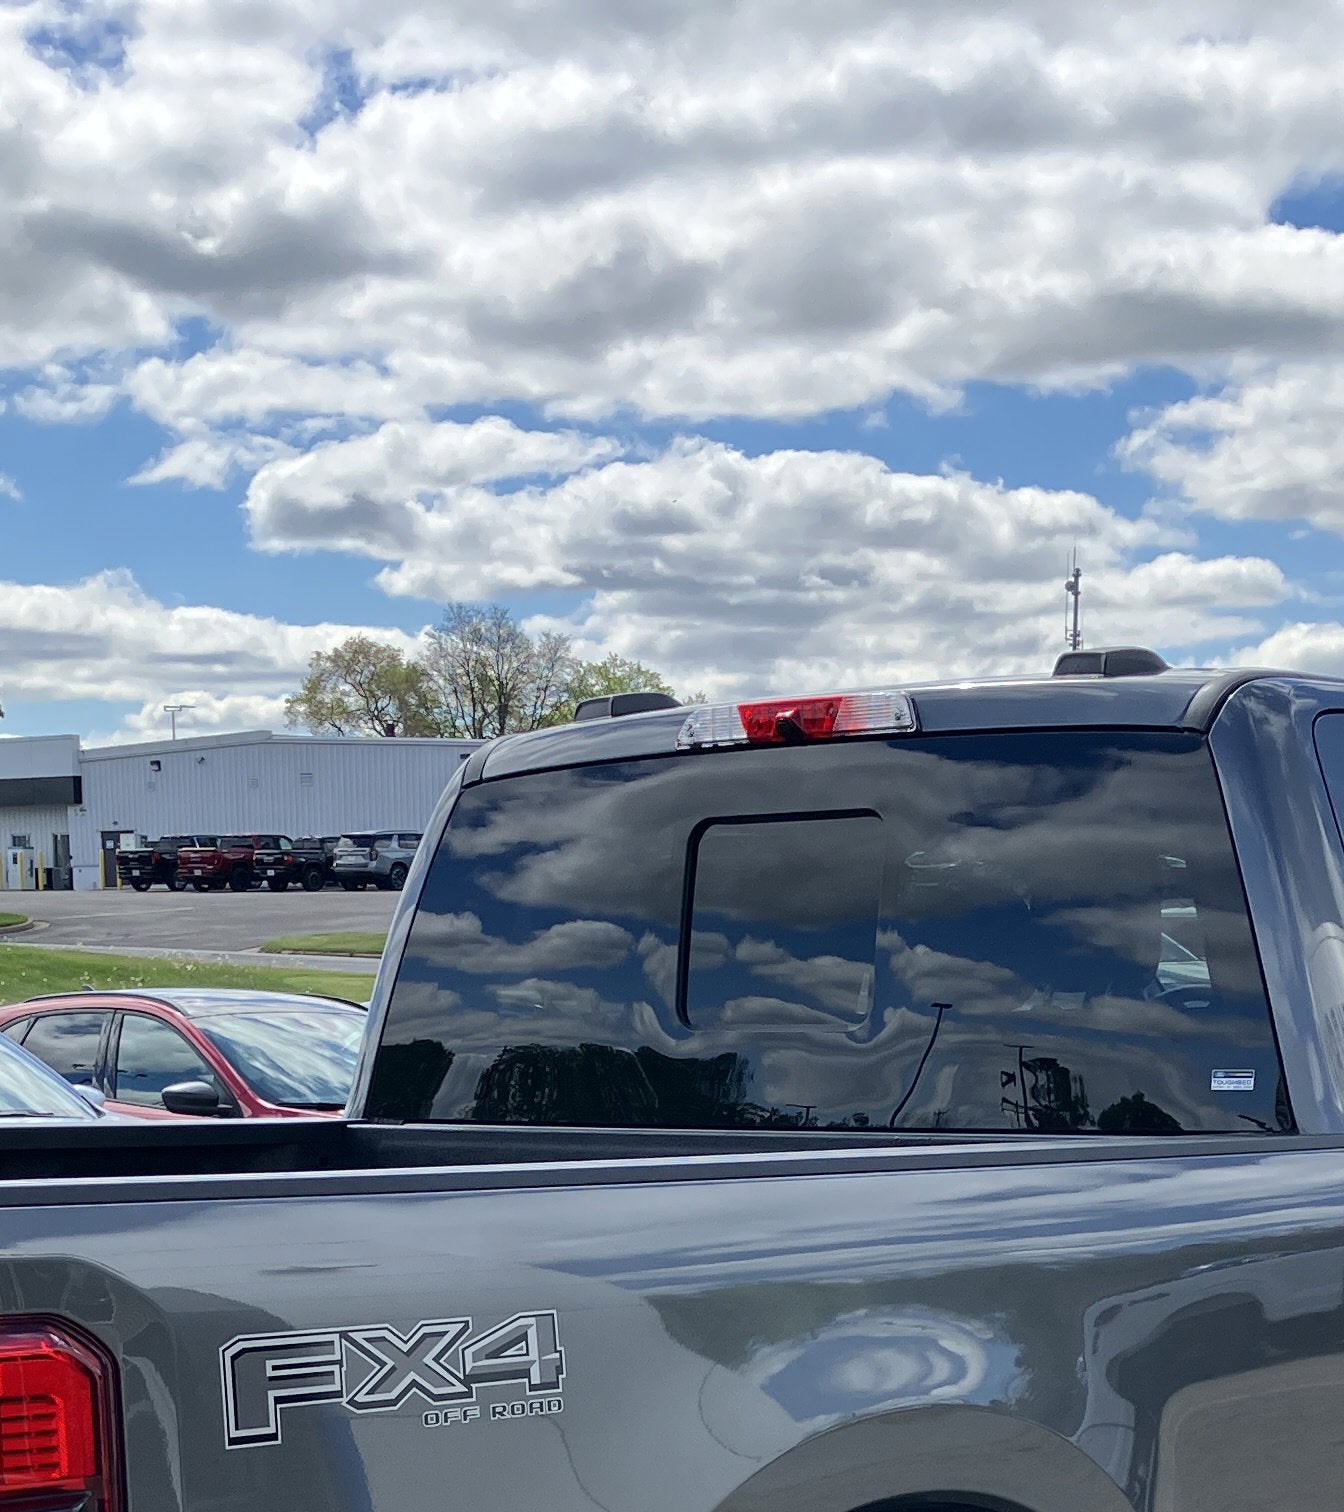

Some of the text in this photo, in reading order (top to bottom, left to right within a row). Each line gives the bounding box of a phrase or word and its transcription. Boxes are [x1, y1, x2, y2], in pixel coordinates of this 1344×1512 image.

[219, 1309, 566, 1450] FX4
[423, 1397, 563, 1428] OFF ROAD
